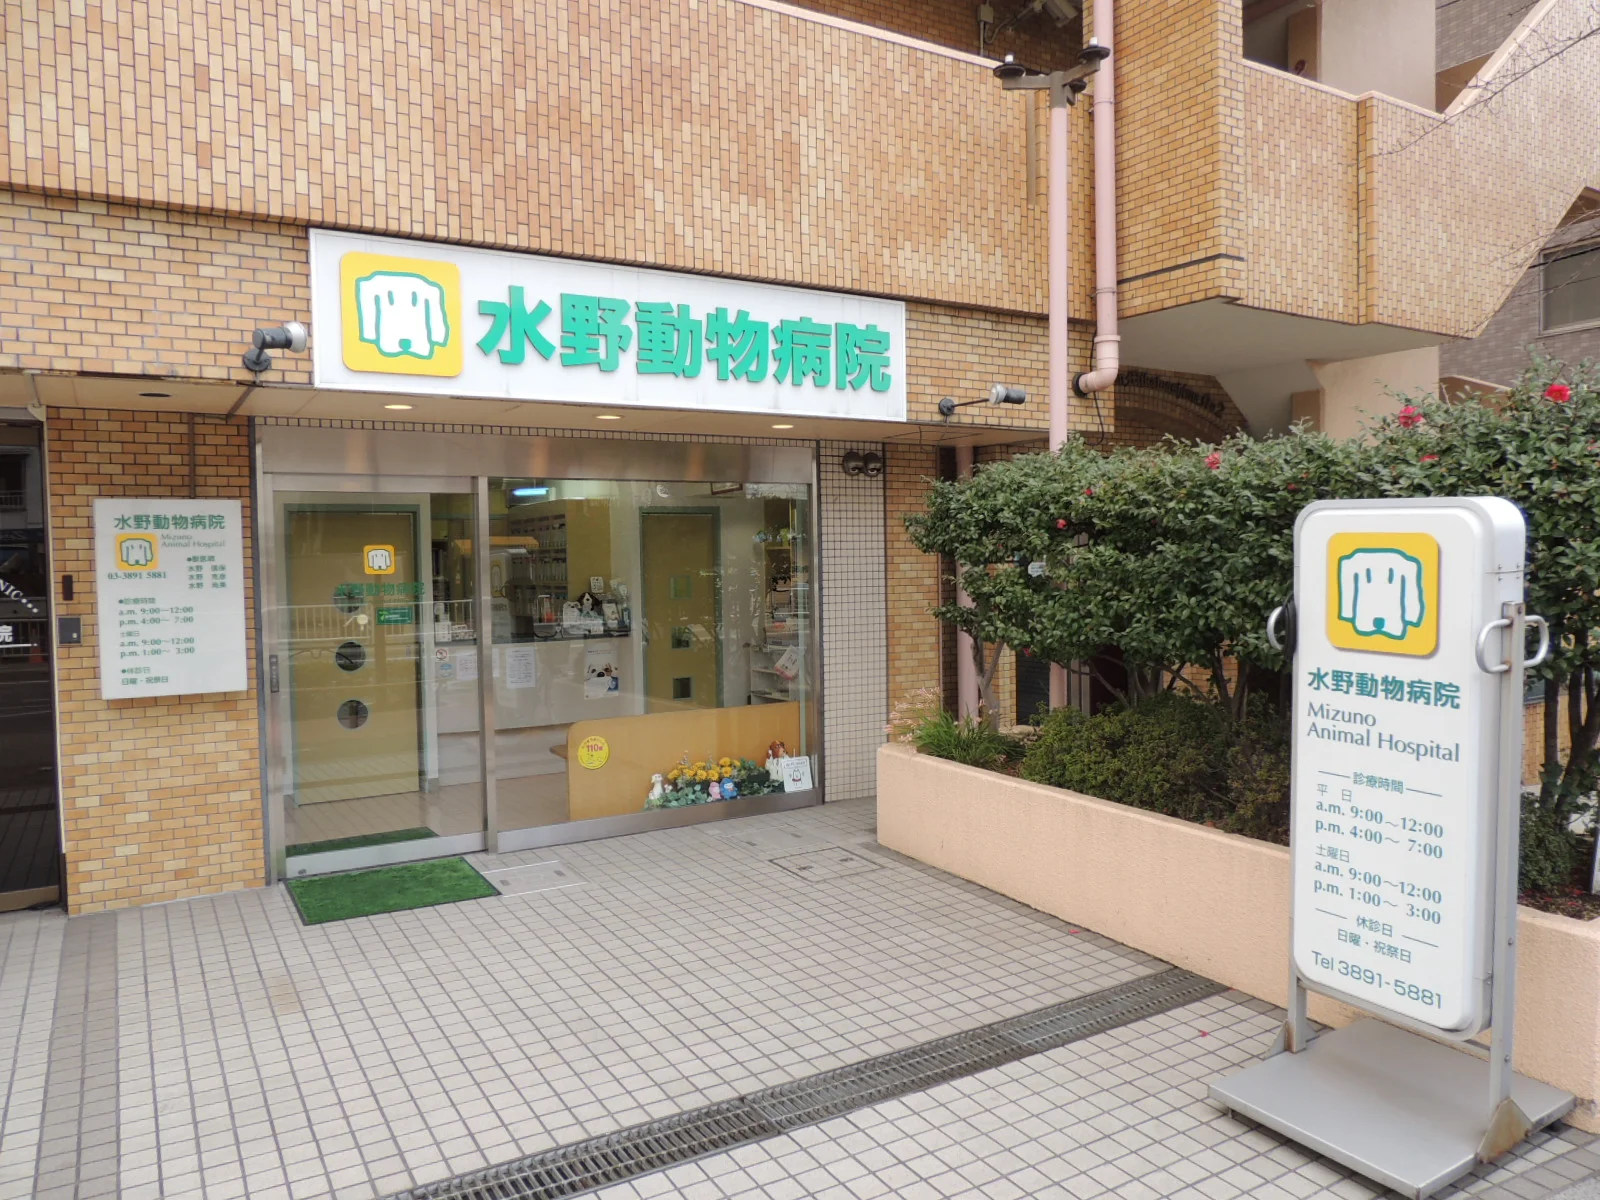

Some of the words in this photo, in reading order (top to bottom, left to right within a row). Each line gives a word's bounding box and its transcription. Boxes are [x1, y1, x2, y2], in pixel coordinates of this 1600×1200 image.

[477, 285, 893, 391] 水野動物病院
[114, 514, 225, 530] 水野動物病院
[193, 540, 226, 549] Hospital
[119, 619, 139, 628] p.m.
[120, 650, 140, 659] p.m.
[1307, 666, 1461, 709] 水野動物病院
[1307, 701, 1377, 727] Mizuno
[1306, 721, 1371, 747] Animal
[1378, 732, 1460, 763] Hospital
[1352, 771, 1404, 794] 診療時間
[1315, 800, 1346, 816] a.m.
[1315, 819, 1345, 835] p.m.
[1407, 838, 1443, 859] 7:00
[1315, 844, 1350, 863] 土曜日
[1314, 861, 1344, 877] a.m.
[1313, 879, 1344, 896] p.m.
[1406, 903, 1441, 924] 3:00
[1356, 915, 1393, 938] 休診日
[1337, 928, 1412, 964] 日曜・祝祭日
[1311, 950, 1334, 971] Tel
[1337, 959, 1442, 1009] 3891-5881
